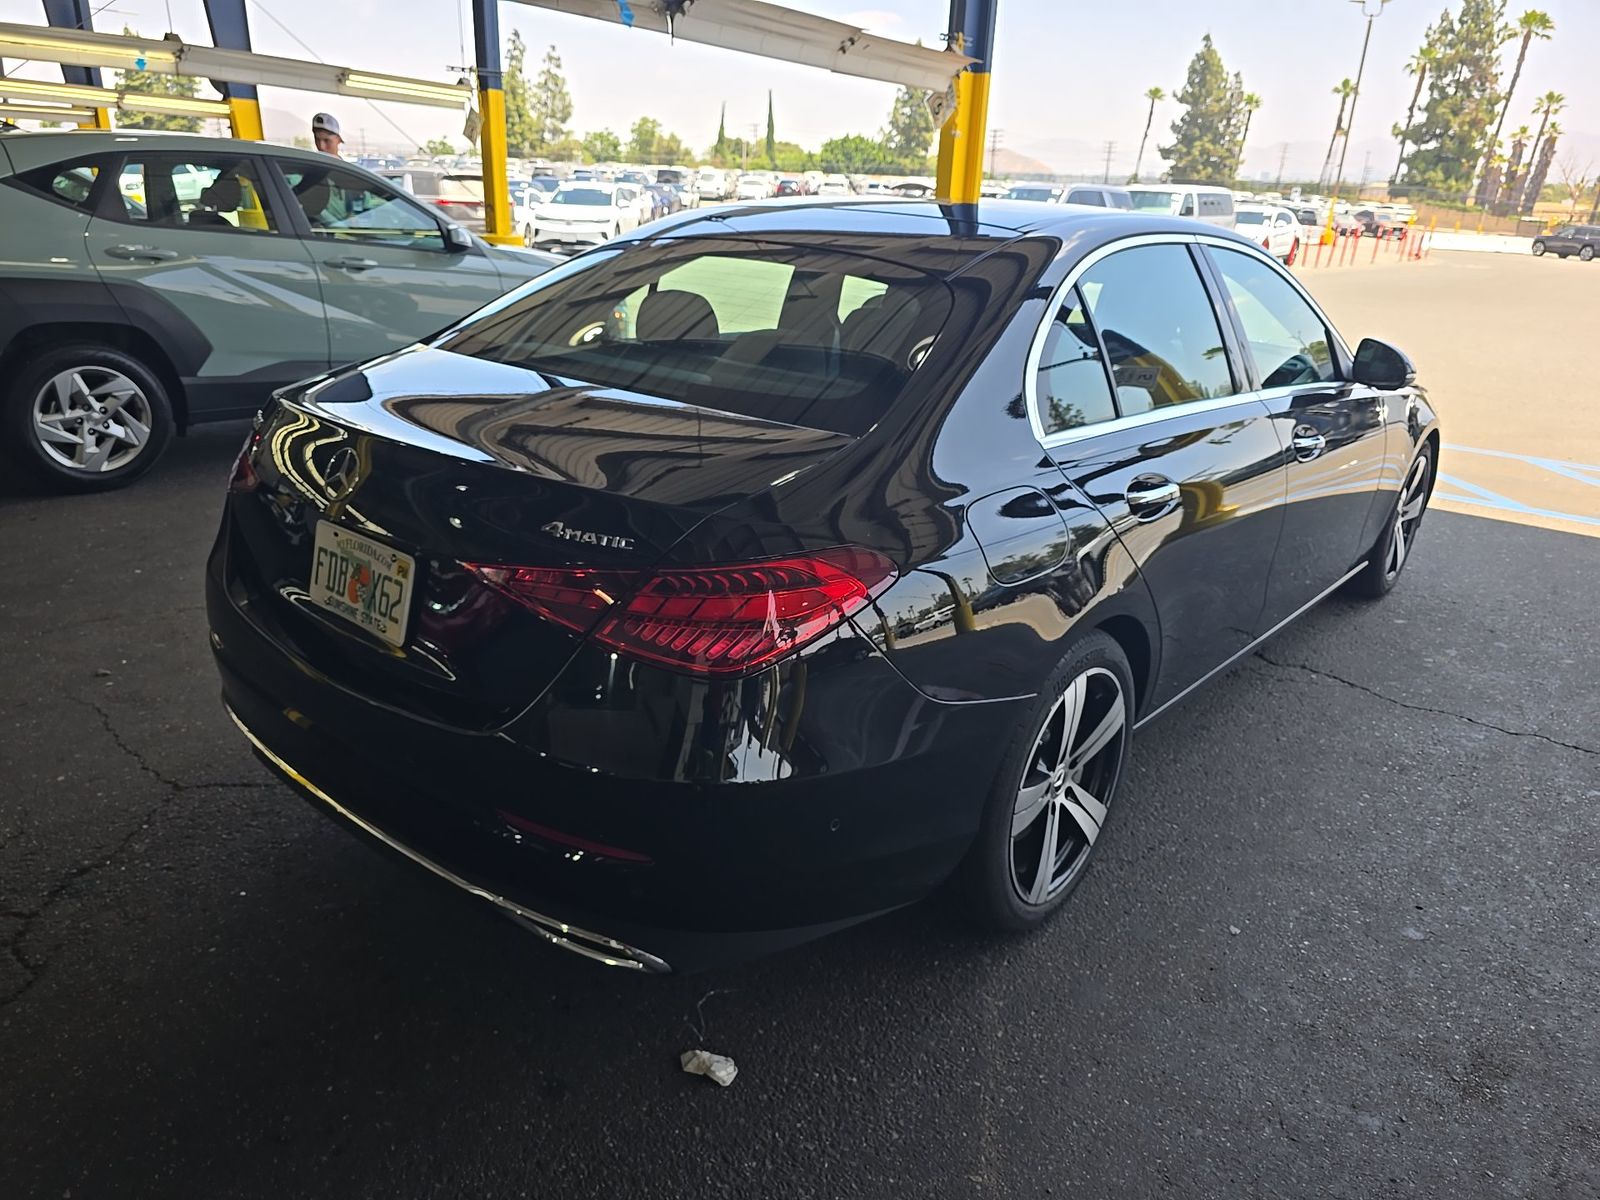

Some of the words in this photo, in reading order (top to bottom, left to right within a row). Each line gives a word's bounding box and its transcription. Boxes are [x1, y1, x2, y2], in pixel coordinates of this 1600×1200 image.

[541, 521, 635, 550] 4MATIC
[315, 546, 349, 597] FDB
[367, 569, 403, 624] X62
